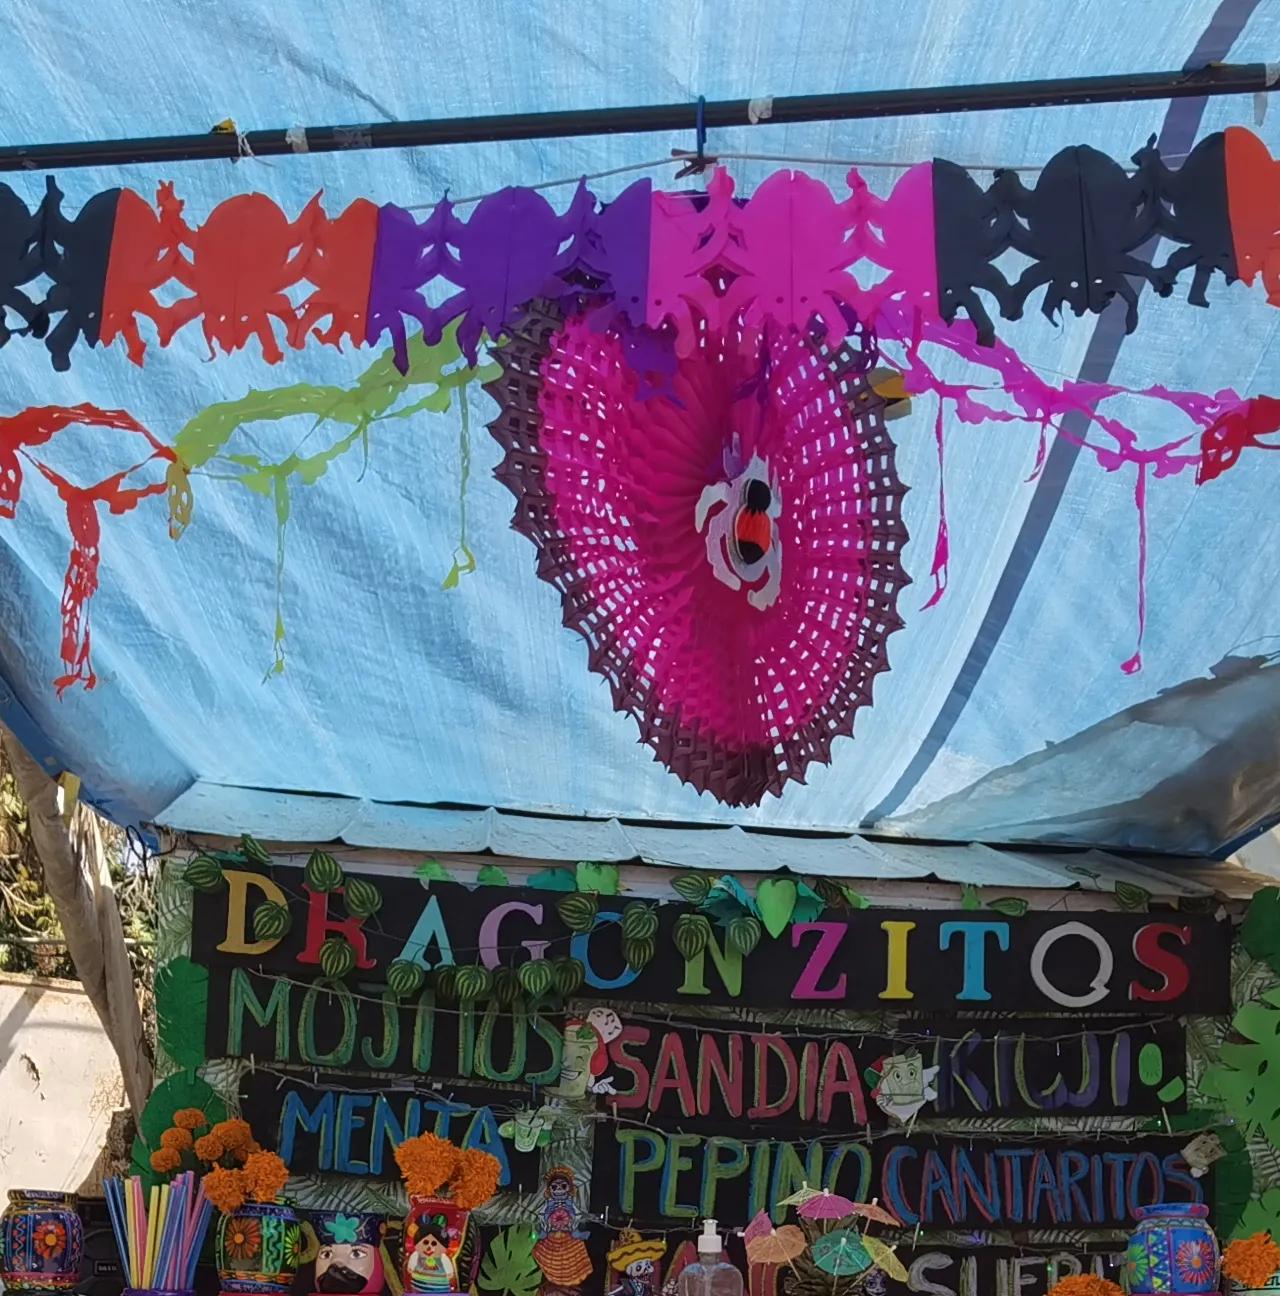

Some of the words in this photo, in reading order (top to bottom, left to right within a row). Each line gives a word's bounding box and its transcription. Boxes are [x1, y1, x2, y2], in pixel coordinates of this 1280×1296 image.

[606, 1025, 867, 1126] SANDIA
[934, 1028, 1131, 1113] KIWI
[278, 1090, 511, 1187] MENTA
[619, 1128, 873, 1220] PEPINO
[880, 1143, 1205, 1227] CANTARITOS
